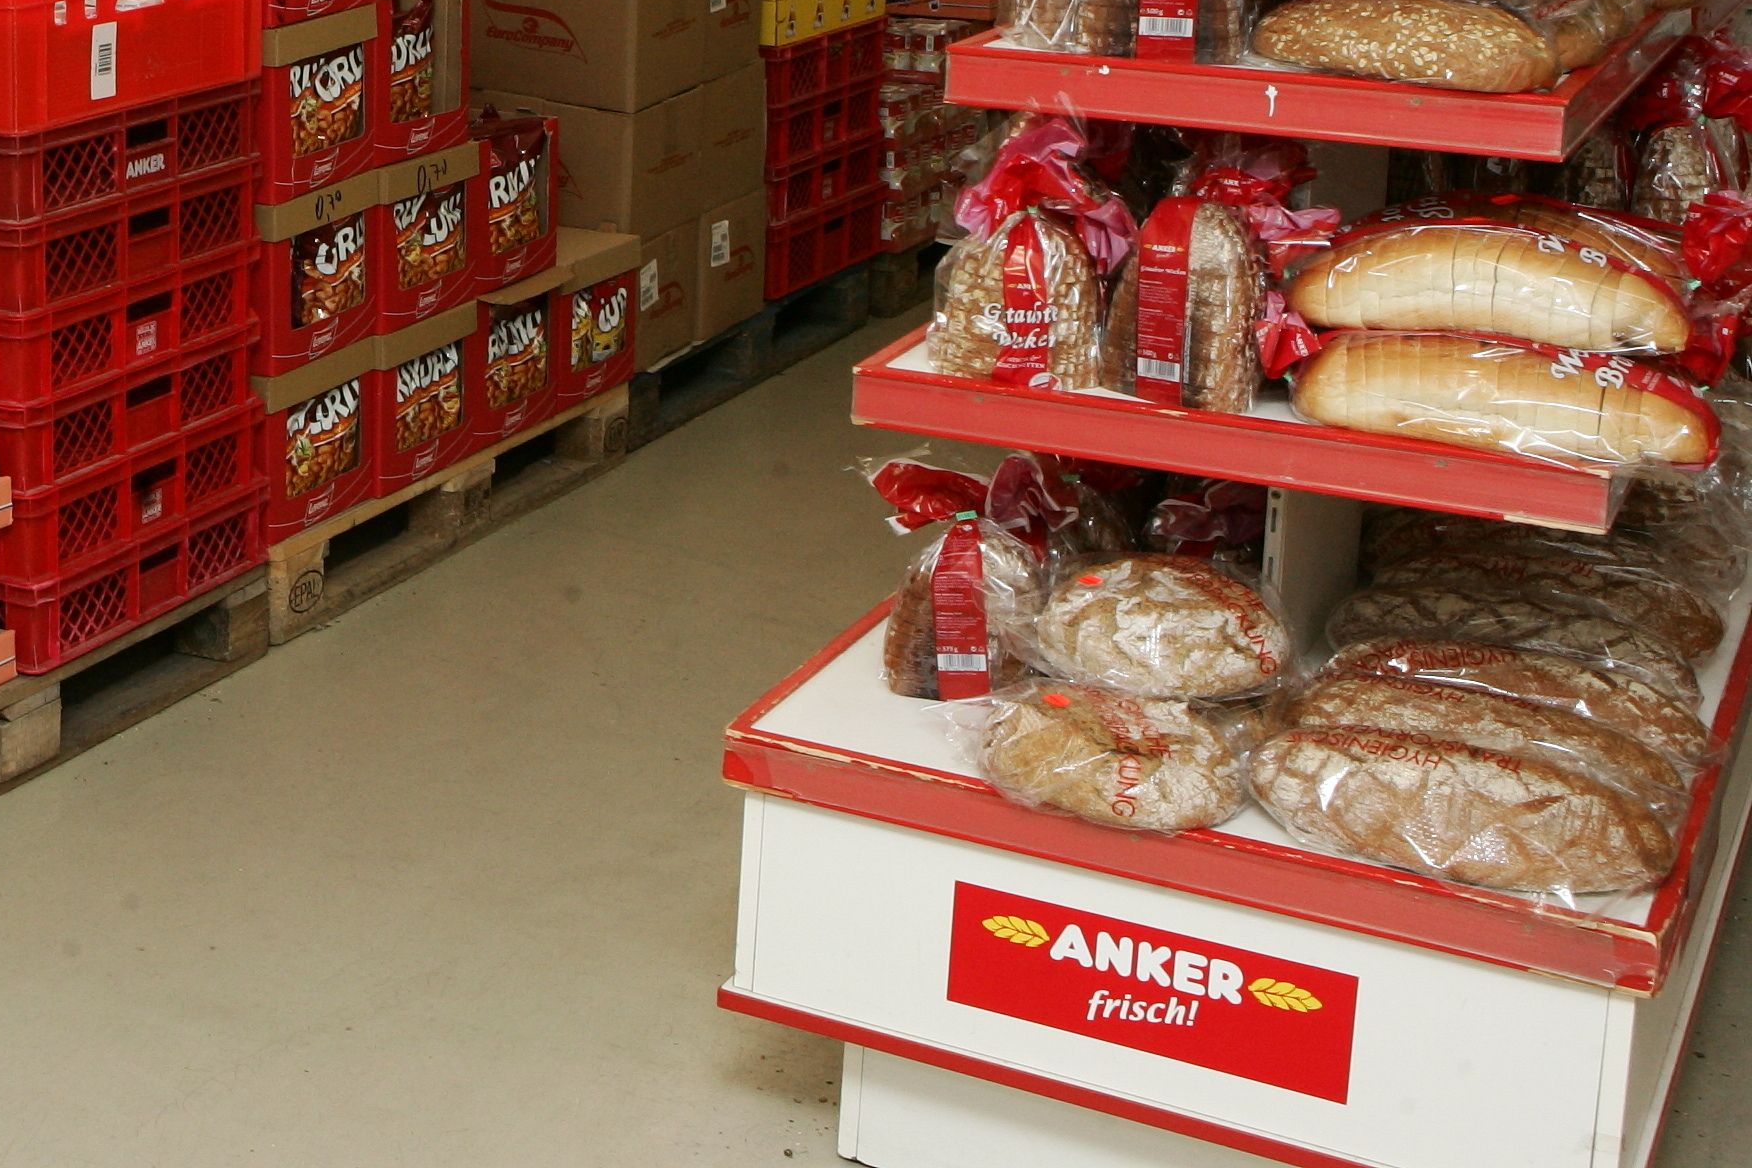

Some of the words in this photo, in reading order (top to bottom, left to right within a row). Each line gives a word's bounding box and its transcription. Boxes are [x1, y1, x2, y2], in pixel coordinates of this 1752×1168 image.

[486, 27, 574, 53] EuroCompany
[126, 153, 165, 179] ANKER
[1049, 924, 1244, 1005] ANKER
[1086, 989, 1199, 1027] frisch!
